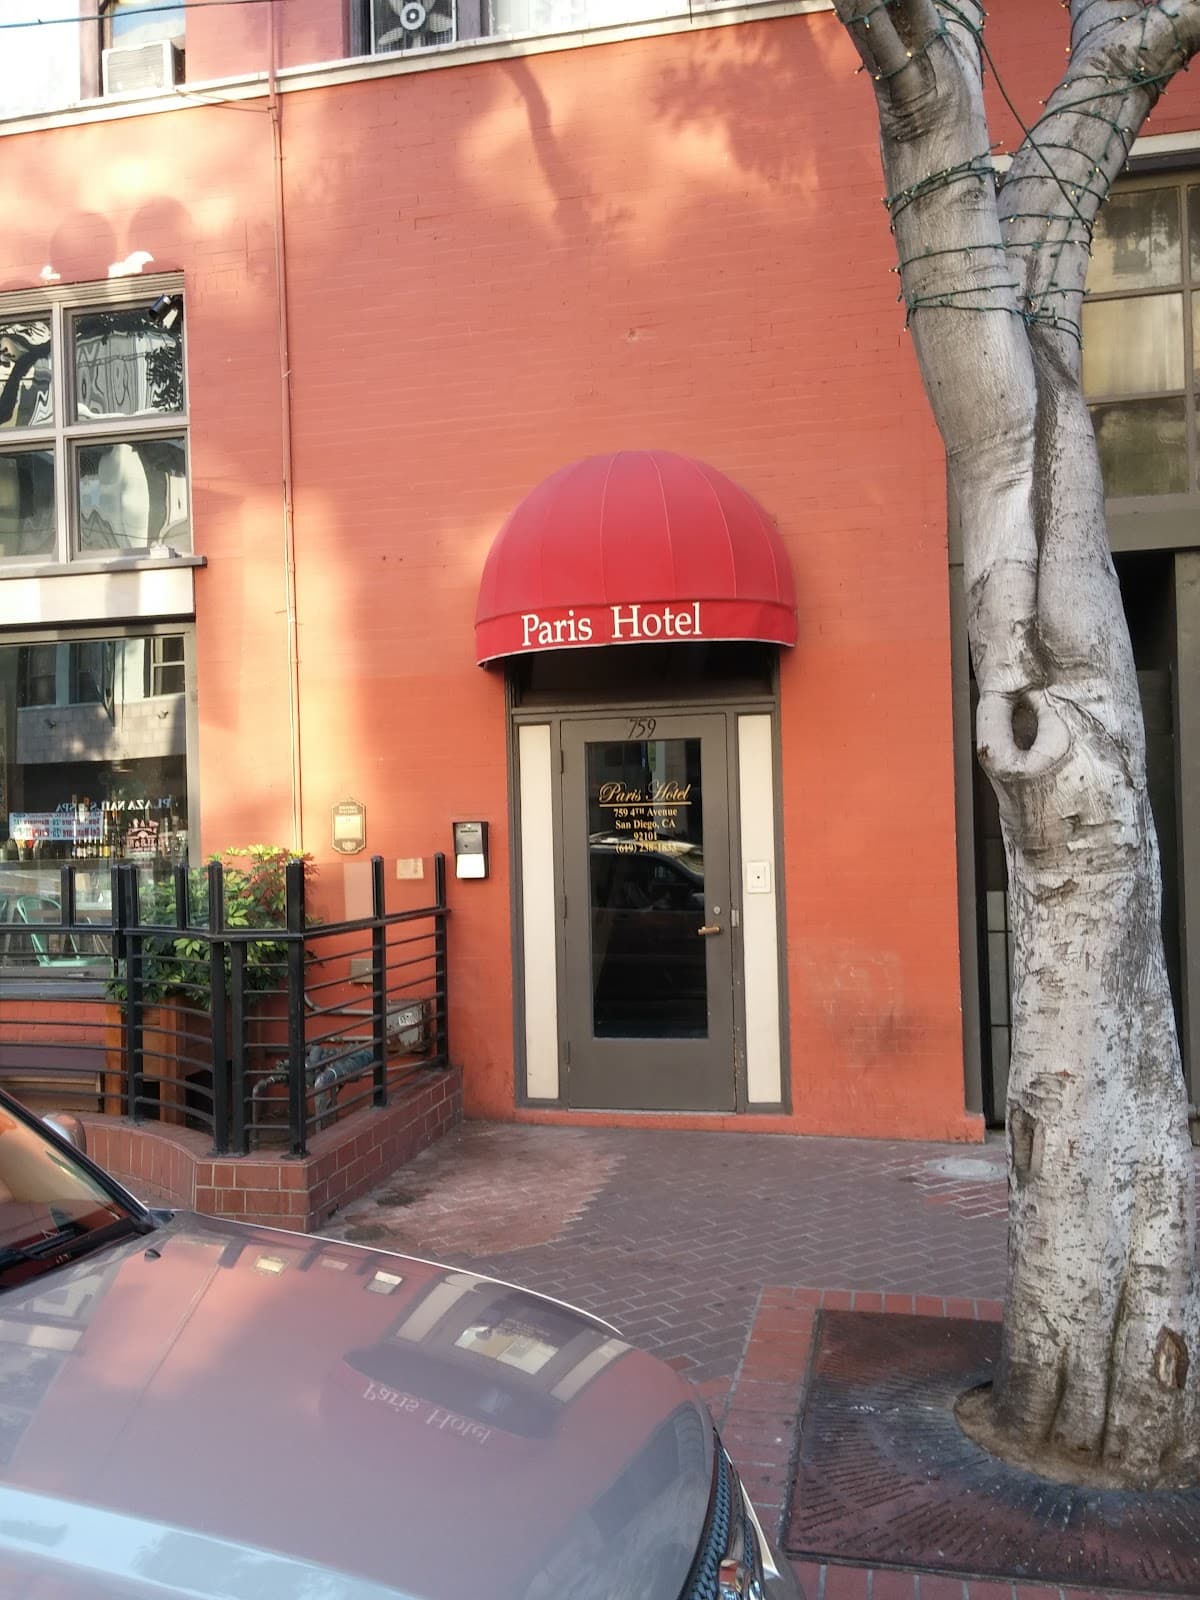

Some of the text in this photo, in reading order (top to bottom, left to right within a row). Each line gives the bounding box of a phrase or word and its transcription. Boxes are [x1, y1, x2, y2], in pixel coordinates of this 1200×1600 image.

[521, 601, 703, 647] Paris Hotel
[627, 718, 657, 739] 759
[599, 779, 692, 803] Paris Hotel
[613, 807, 678, 818] 759 4TH Avenue
[615, 818, 676, 830] San Diego, CA
[633, 831, 658, 841] 92101
